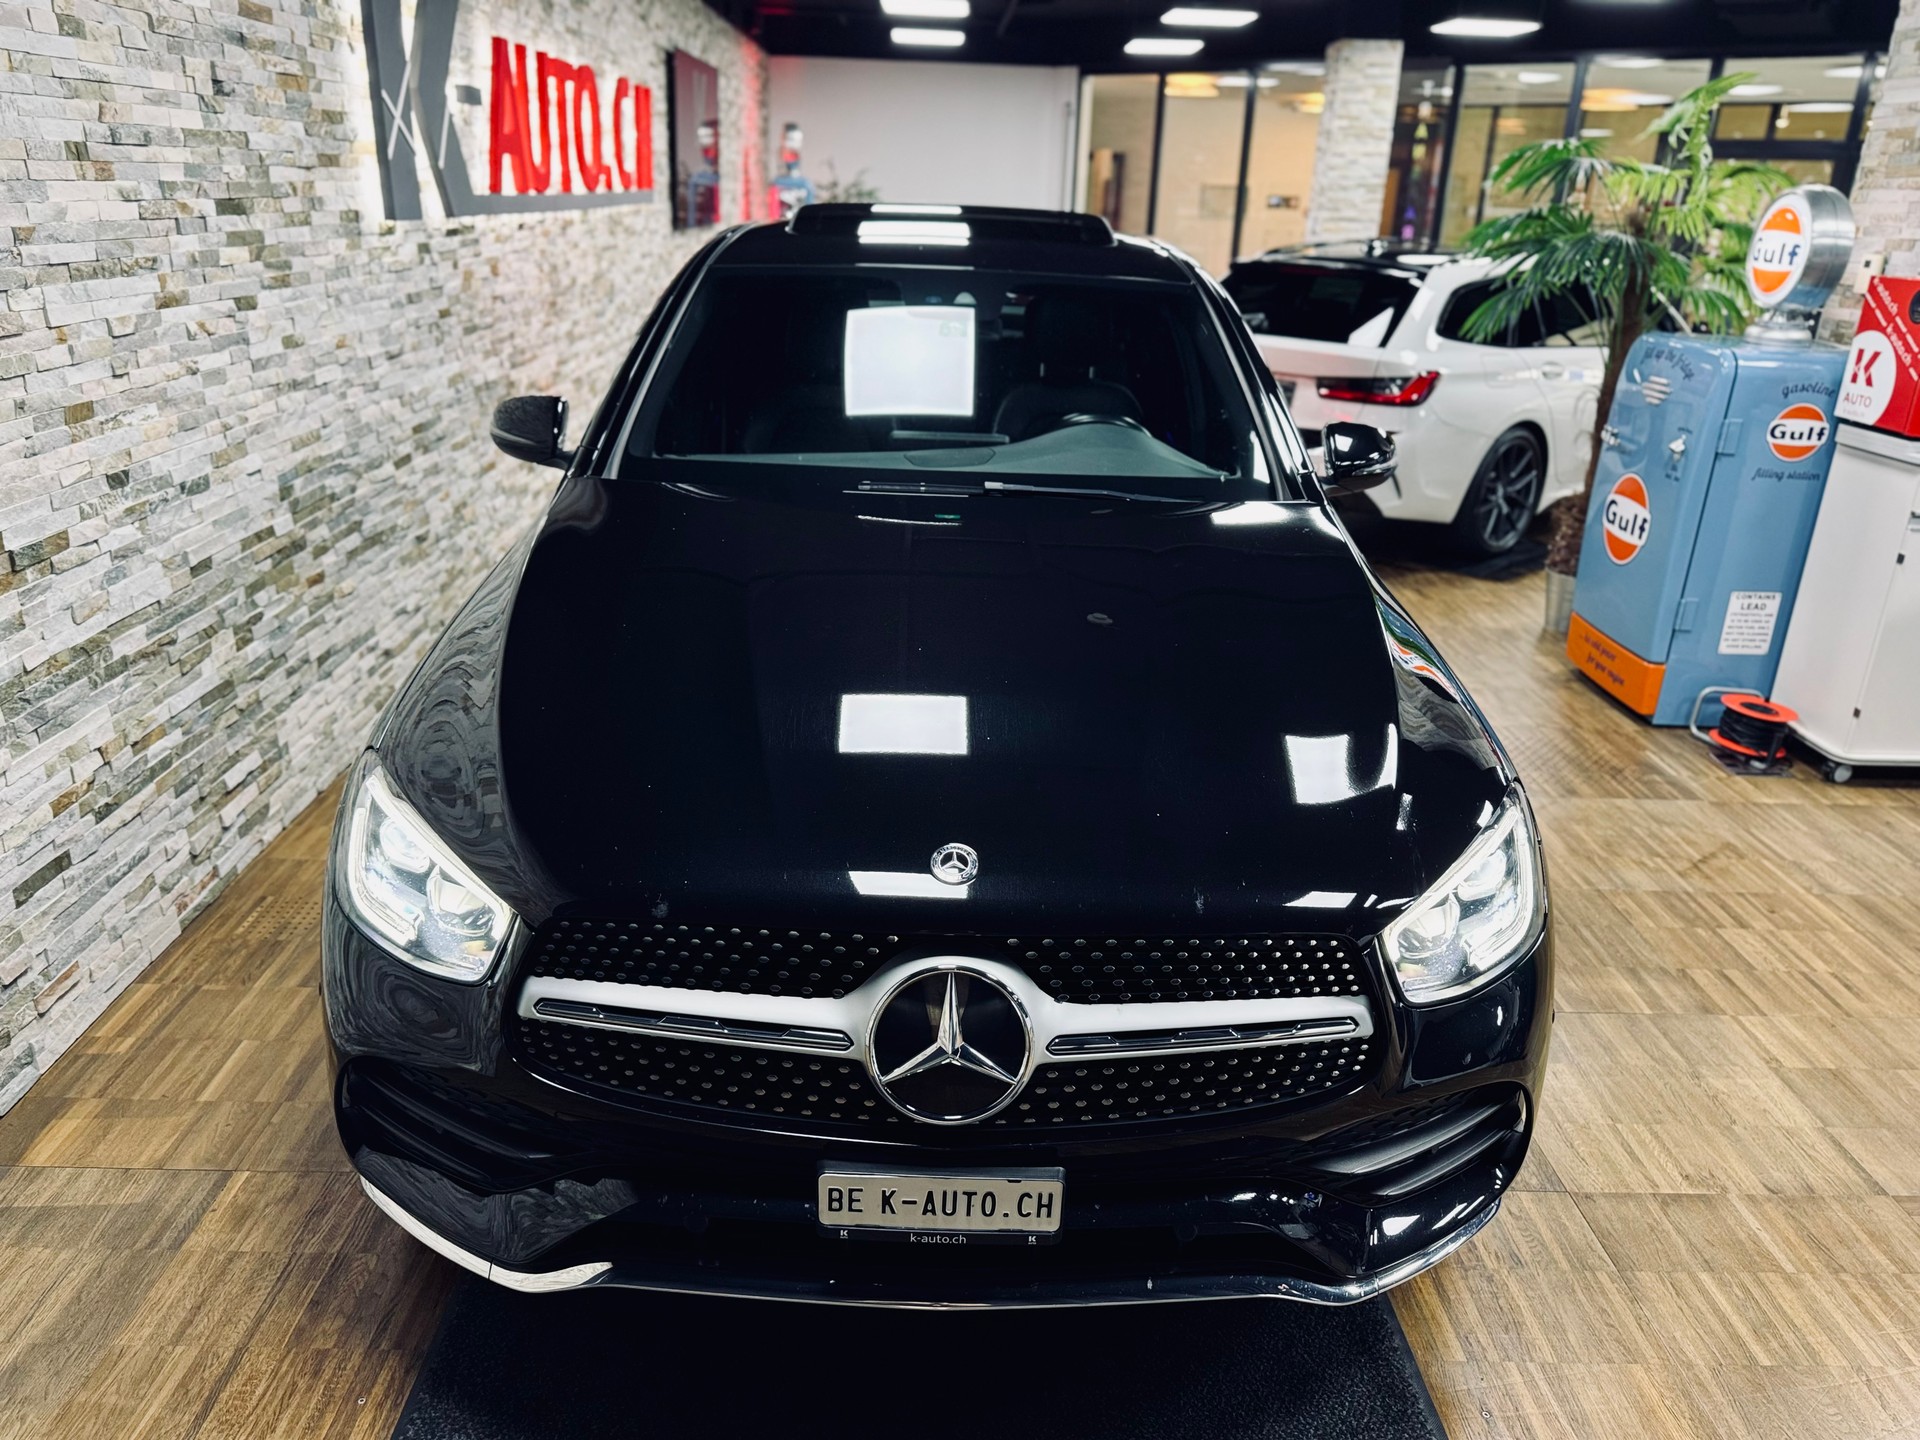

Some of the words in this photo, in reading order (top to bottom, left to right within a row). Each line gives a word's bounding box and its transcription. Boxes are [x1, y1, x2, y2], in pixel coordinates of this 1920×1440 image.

[1851, 348, 1881, 387] K
[1782, 382, 1836, 399] gasoline
[1843, 392, 1872, 408] AUTO
[1770, 423, 1827, 442] Gulf
[1751, 467, 1784, 482] filling
[1786, 470, 1820, 481] station
[1606, 499, 1648, 540] Gulf
[827, 1188, 863, 1212] BE
[881, 1189, 1054, 1218] K-AUTO.CH
[910, 1233, 967, 1244] k-auto.ch
